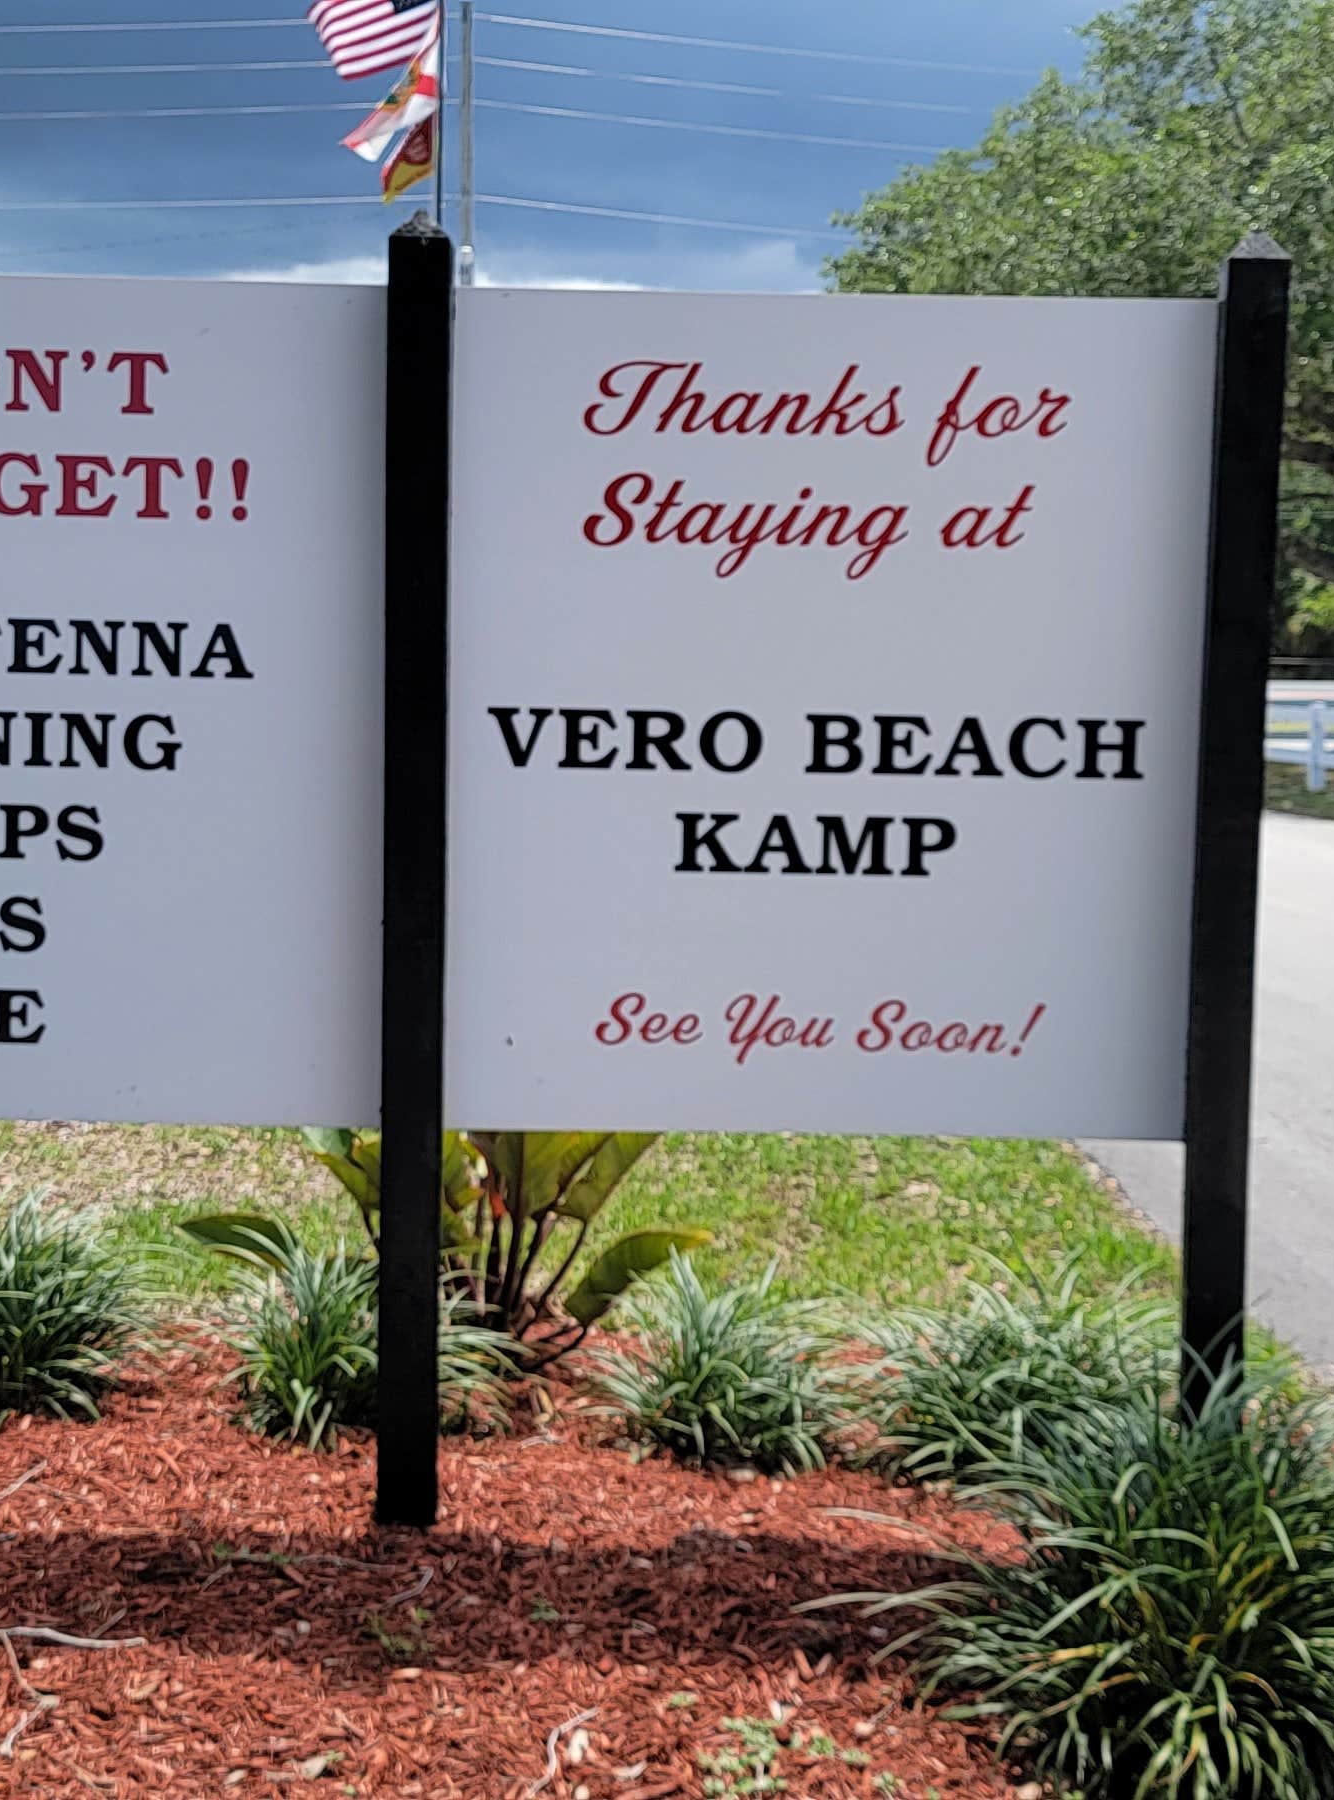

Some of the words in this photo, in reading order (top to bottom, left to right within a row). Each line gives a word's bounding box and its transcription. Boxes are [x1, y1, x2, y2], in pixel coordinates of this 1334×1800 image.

[582, 360, 905, 437] Thanks
[925, 365, 1072, 468] for
[581, 472, 909, 581] Staying
[939, 484, 1036, 549] at
[487, 706, 764, 774] VERO
[803, 713, 1146, 780] BEACH
[673, 811, 958, 878] KAMP
[594, 992, 703, 1046] See
[724, 994, 834, 1065] You
[855, 1000, 1046, 1057] Soon!
